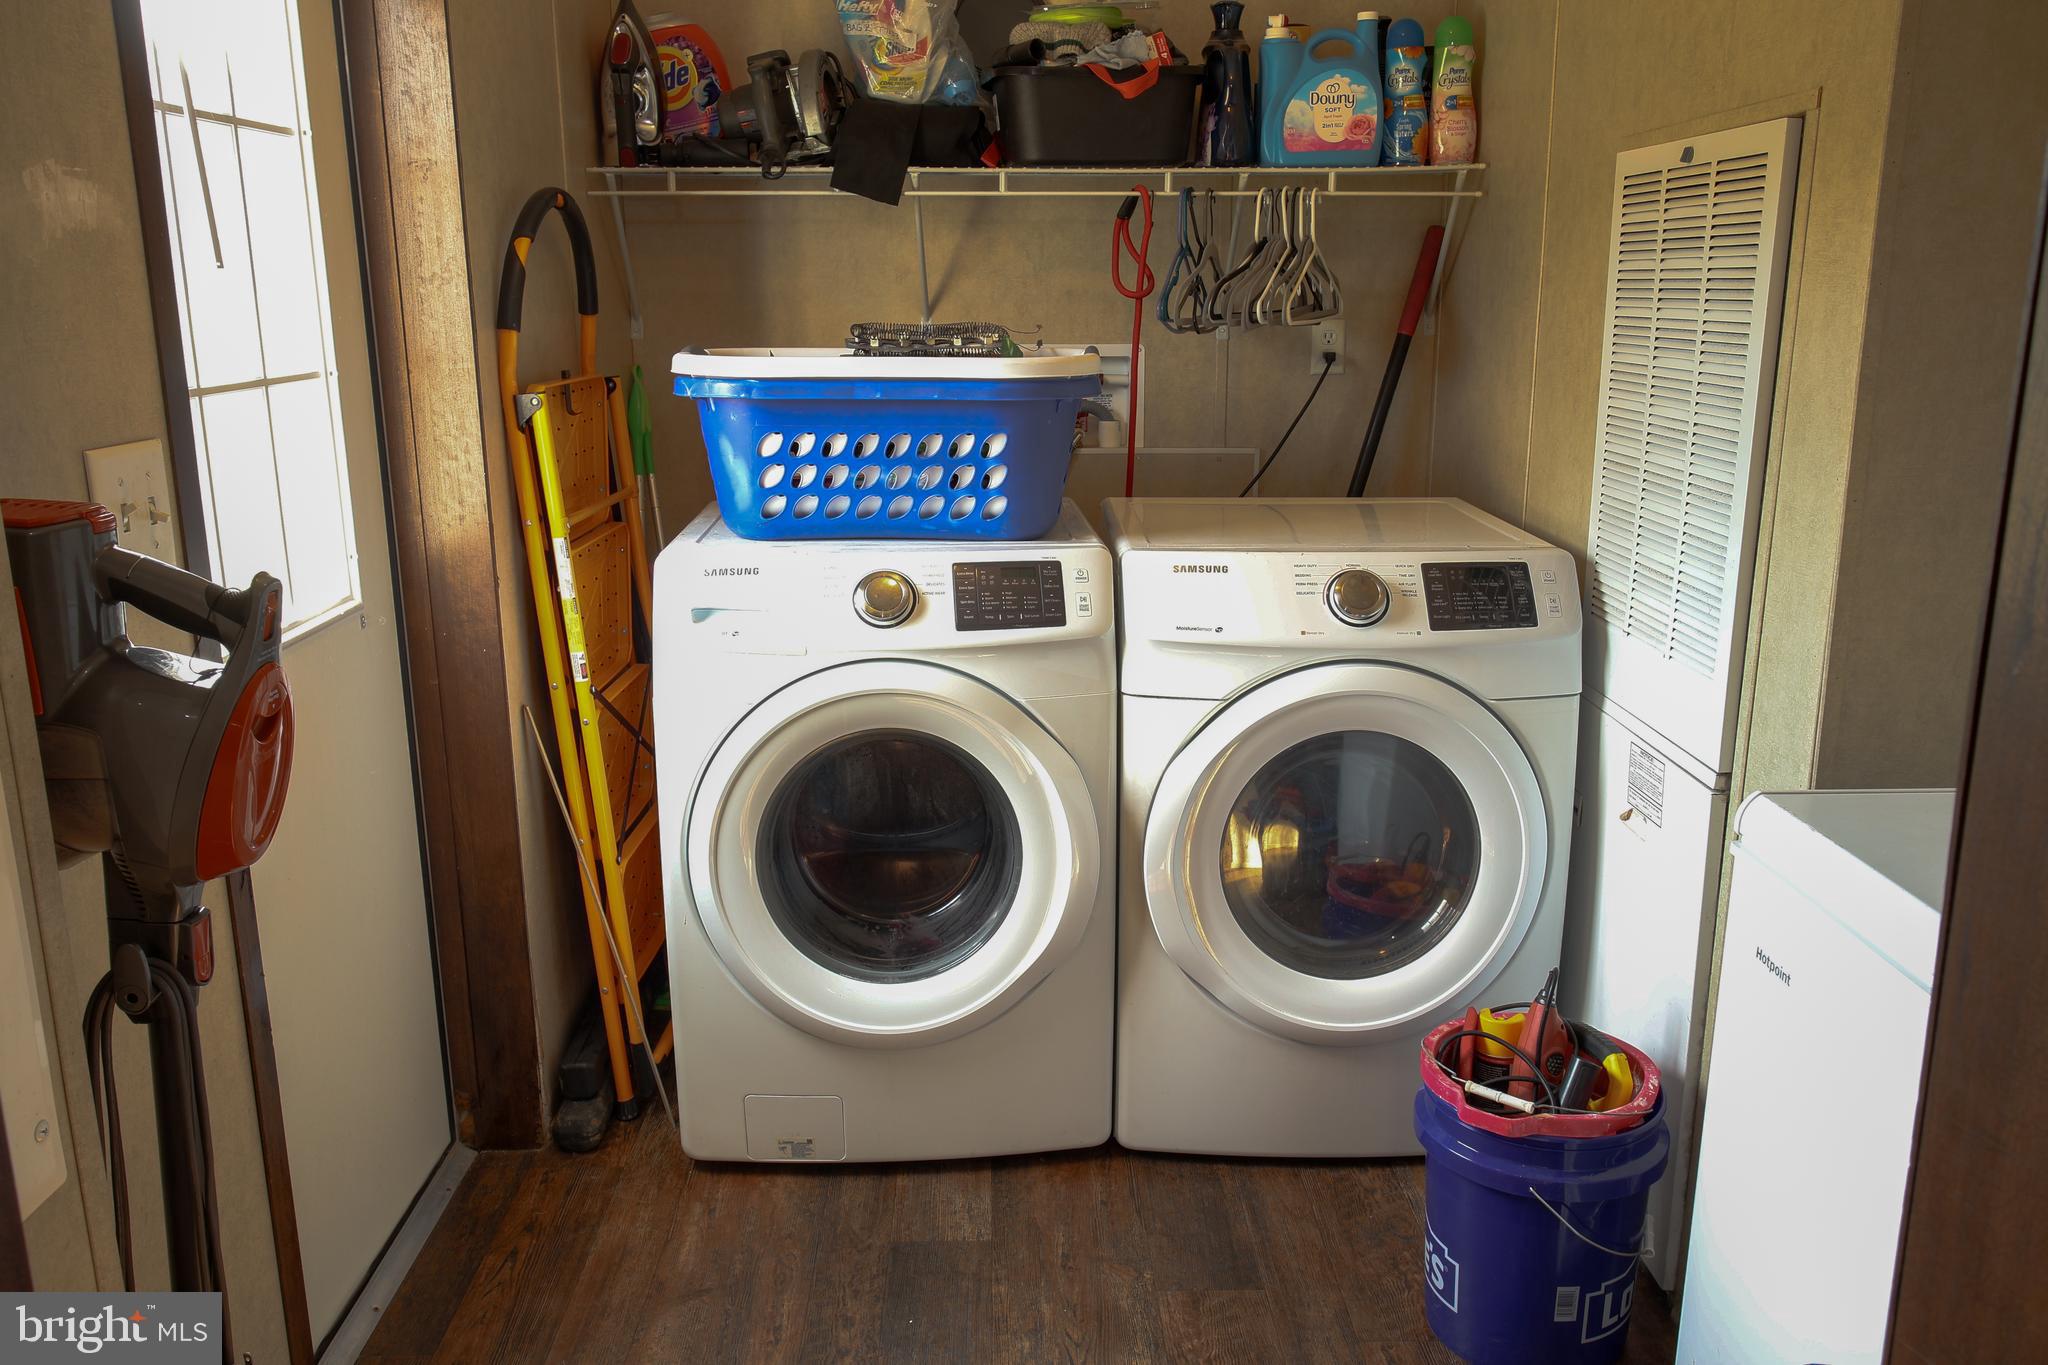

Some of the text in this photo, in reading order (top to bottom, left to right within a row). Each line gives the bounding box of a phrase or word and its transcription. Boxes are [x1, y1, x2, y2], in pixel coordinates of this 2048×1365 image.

[1311, 92, 1355, 108] Downy
[704, 567, 760, 577] SAMSUNG
[1173, 565, 1229, 573] SAMSUNG
[1756, 946, 1791, 986] Hotpoint
